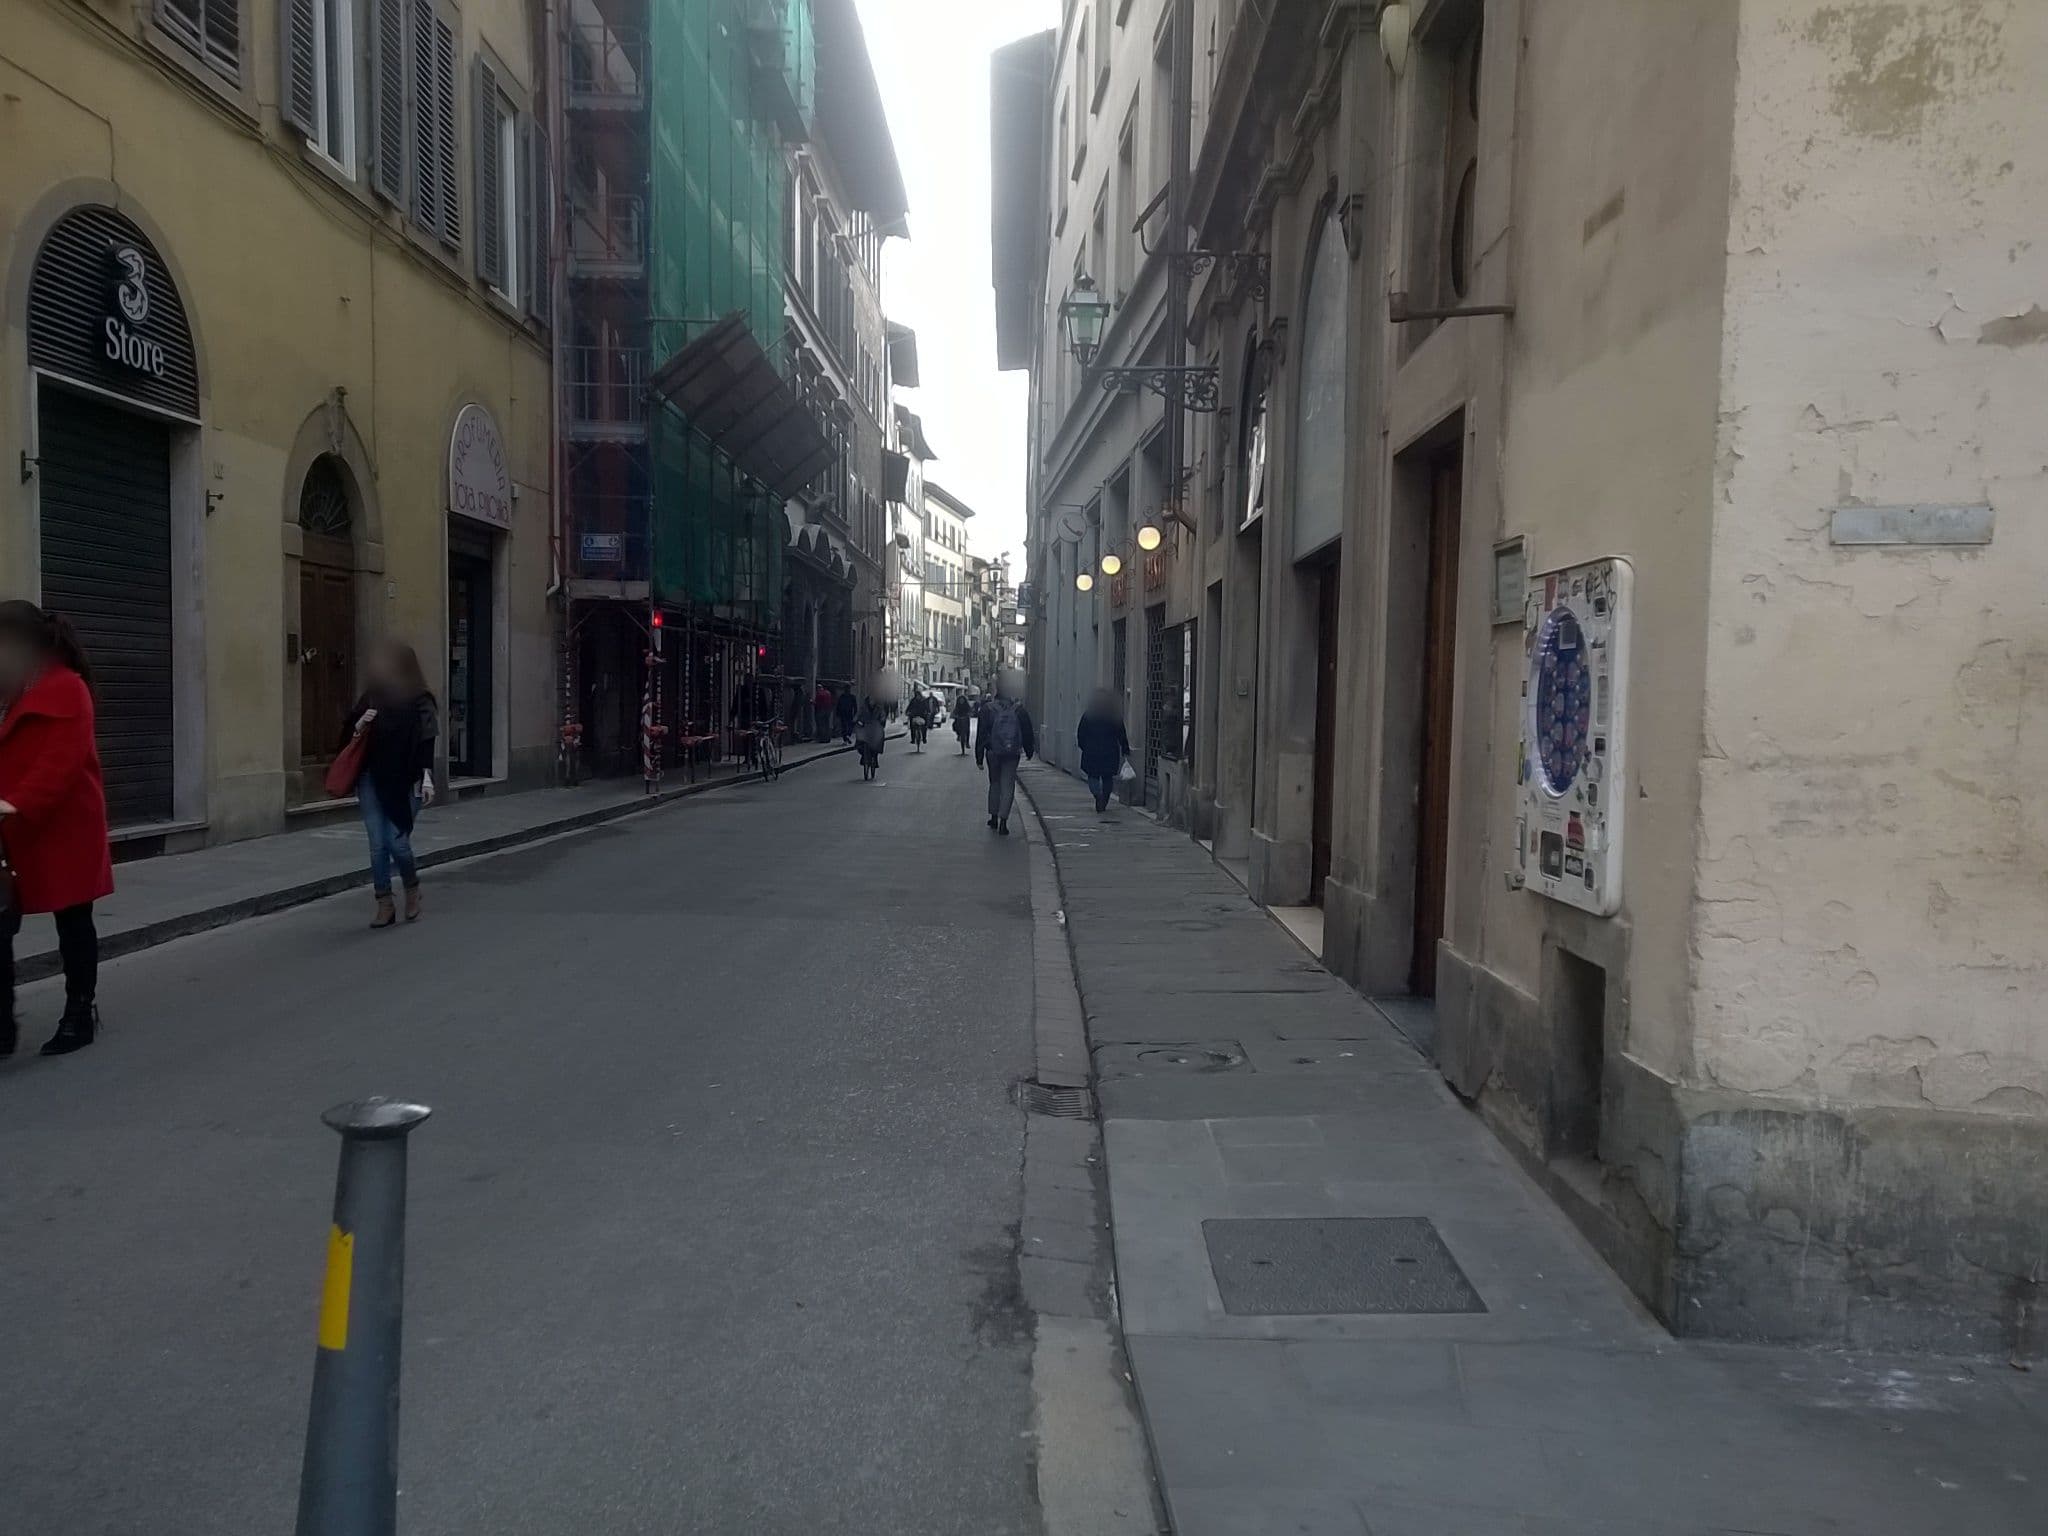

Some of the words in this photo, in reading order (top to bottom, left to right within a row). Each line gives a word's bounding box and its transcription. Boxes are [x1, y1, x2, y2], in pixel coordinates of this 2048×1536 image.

[115, 247, 148, 322] 3
[104, 316, 164, 376] Store
[455, 416, 504, 491] PROFUMERIA
